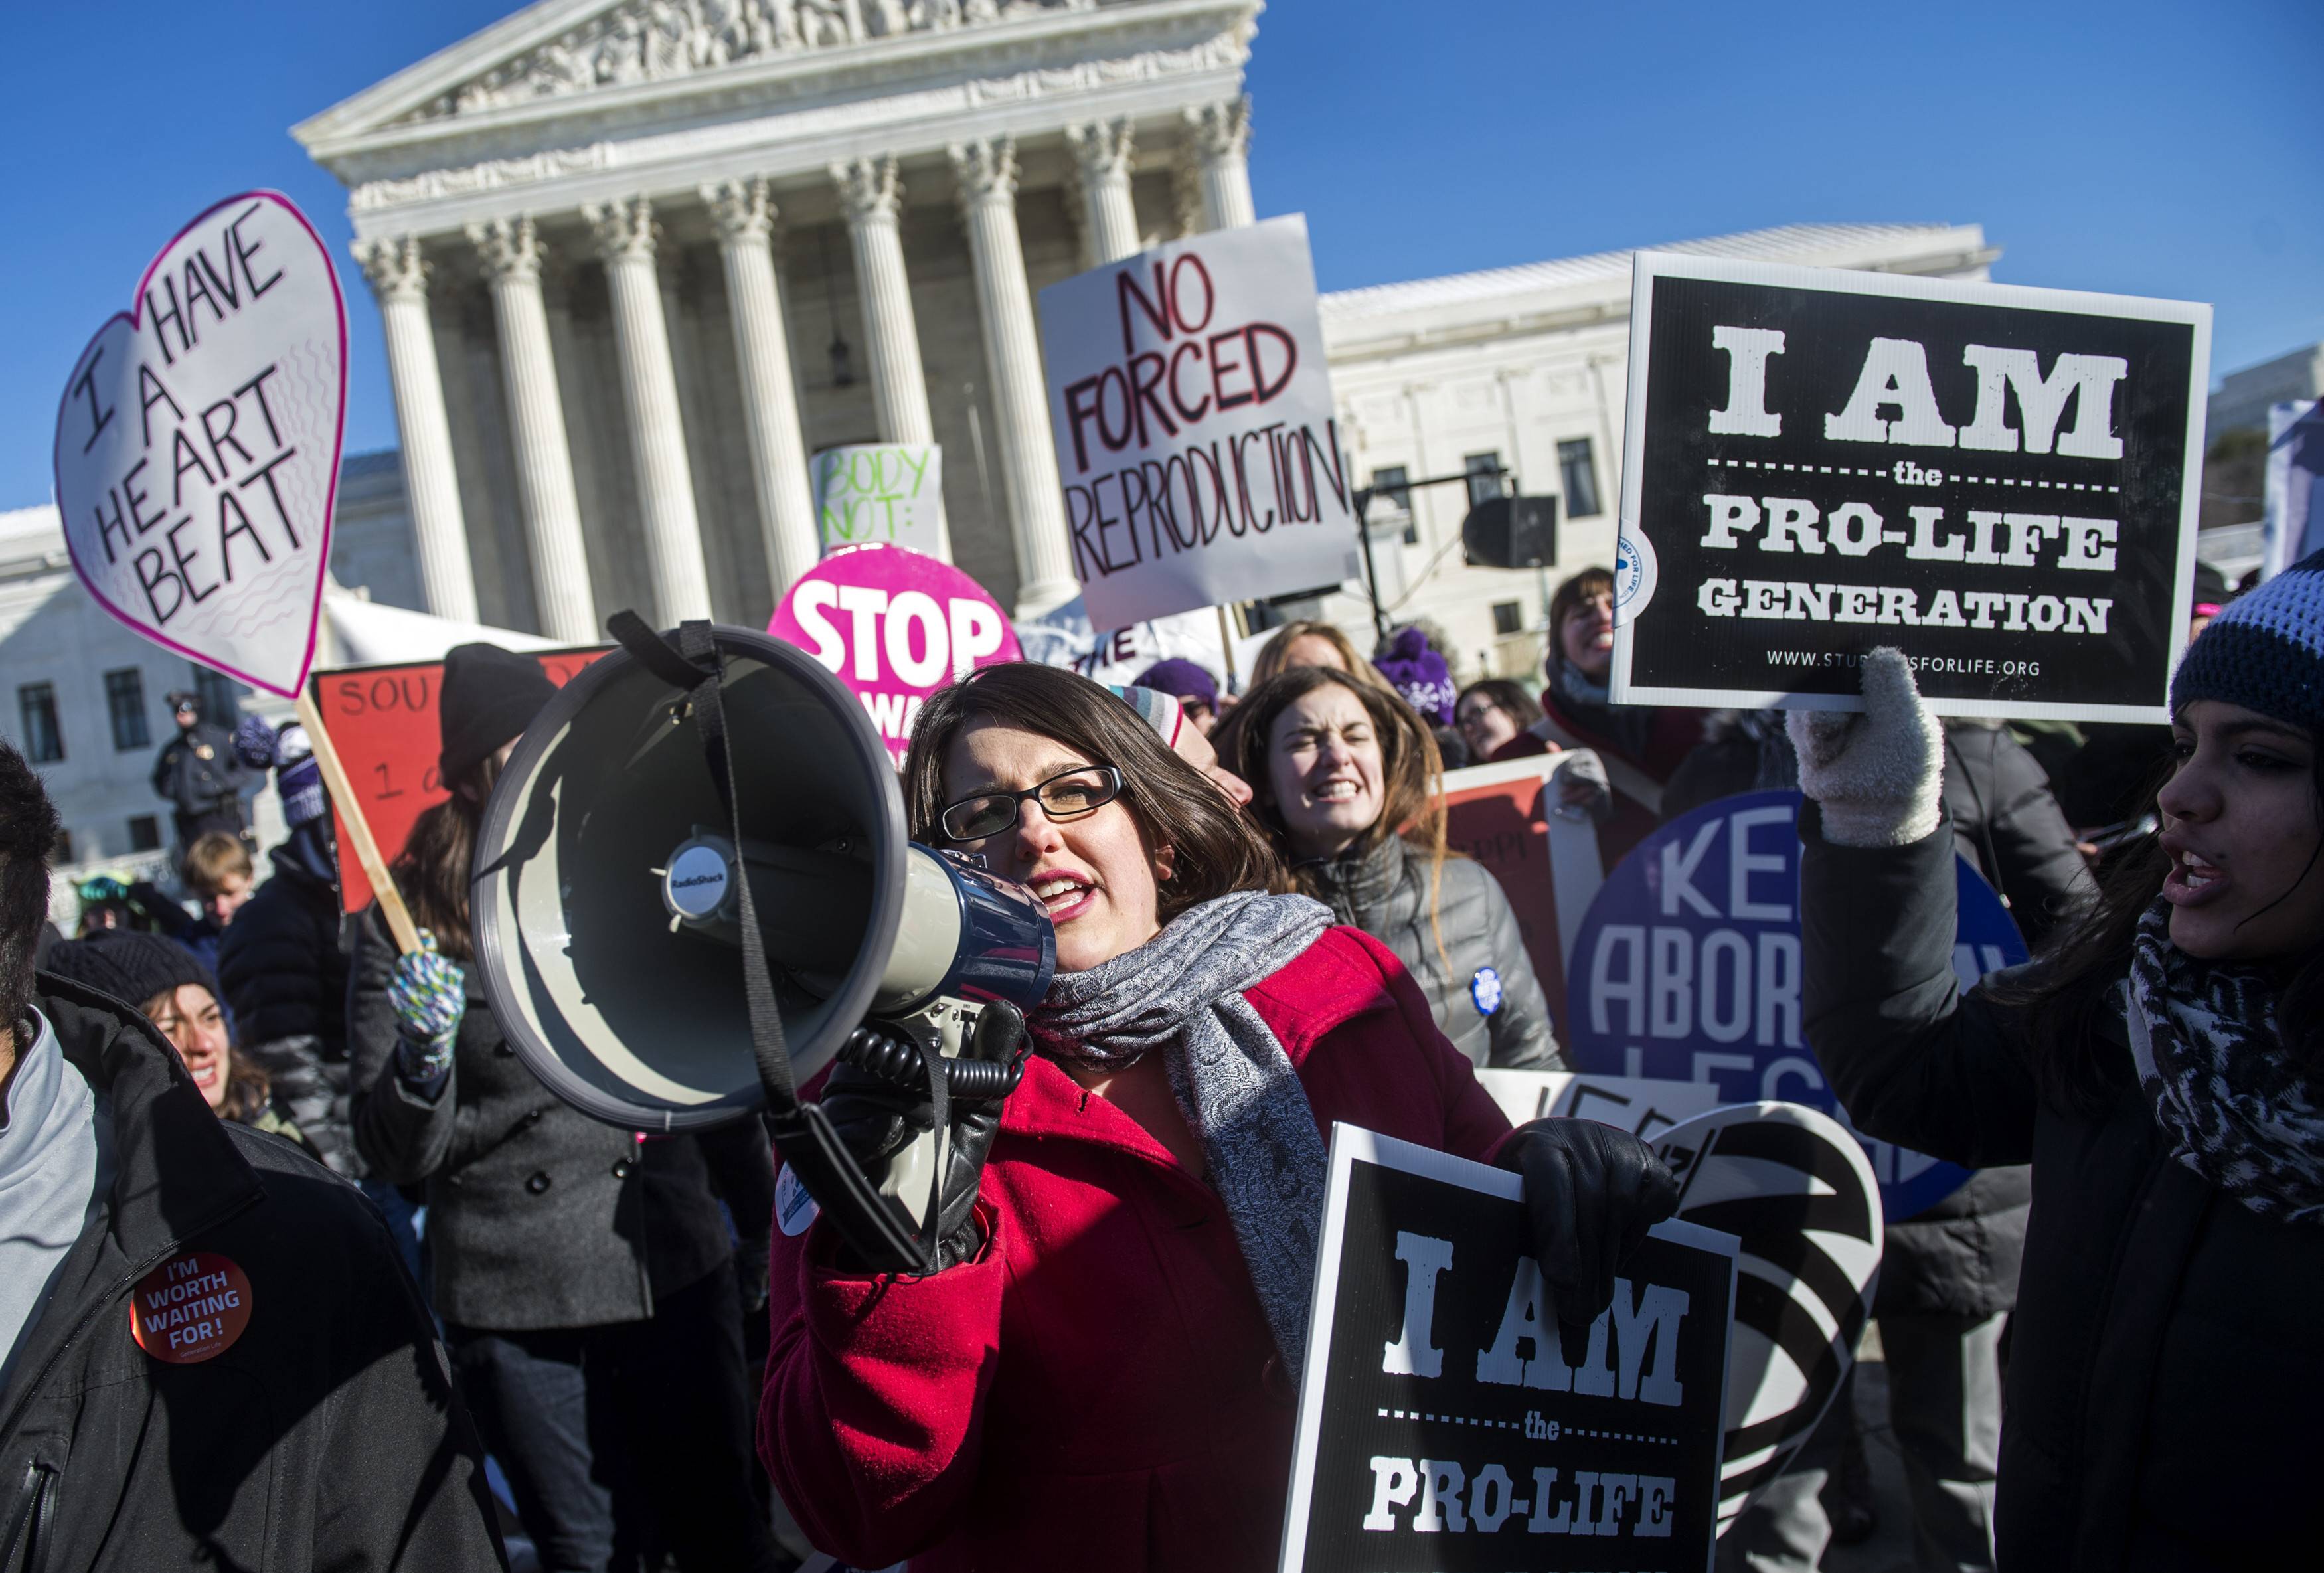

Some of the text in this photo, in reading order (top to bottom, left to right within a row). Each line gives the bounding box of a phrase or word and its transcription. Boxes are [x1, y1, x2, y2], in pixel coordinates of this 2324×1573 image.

[74, 202, 283, 455] I HAVE
[1117, 253, 1214, 356] NO
[139, 363, 184, 447] A
[1064, 321, 1297, 473] FORCED
[1708, 325, 2128, 460] I AM
[95, 365, 282, 564] HEART
[821, 449, 929, 499] BODY
[1064, 417, 1350, 583] REPRODUCTION
[1893, 461, 1943, 487] the
[134, 448, 301, 625] BEAT
[1630, 554, 1639, 572] FOR
[1700, 494, 2118, 570] PRO-LIFE
[793, 580, 1003, 688] STOP
[1697, 578, 2114, 635] GENERATION
[374, 762, 404, 801] 1
[672, 873, 723, 888] RadioShack
[1661, 805, 1802, 922] KE
[146, 1270, 228, 1309] WORTH
[167, 1258, 198, 1282] I'M
[145, 1290, 240, 1333] WAITING
[1383, 1230, 1690, 1407] I AM
[181, 1346, 210, 1358] Generation
[1525, 1410, 1559, 1441] the
[1363, 1455, 1676, 1537] PRO-LIFE
